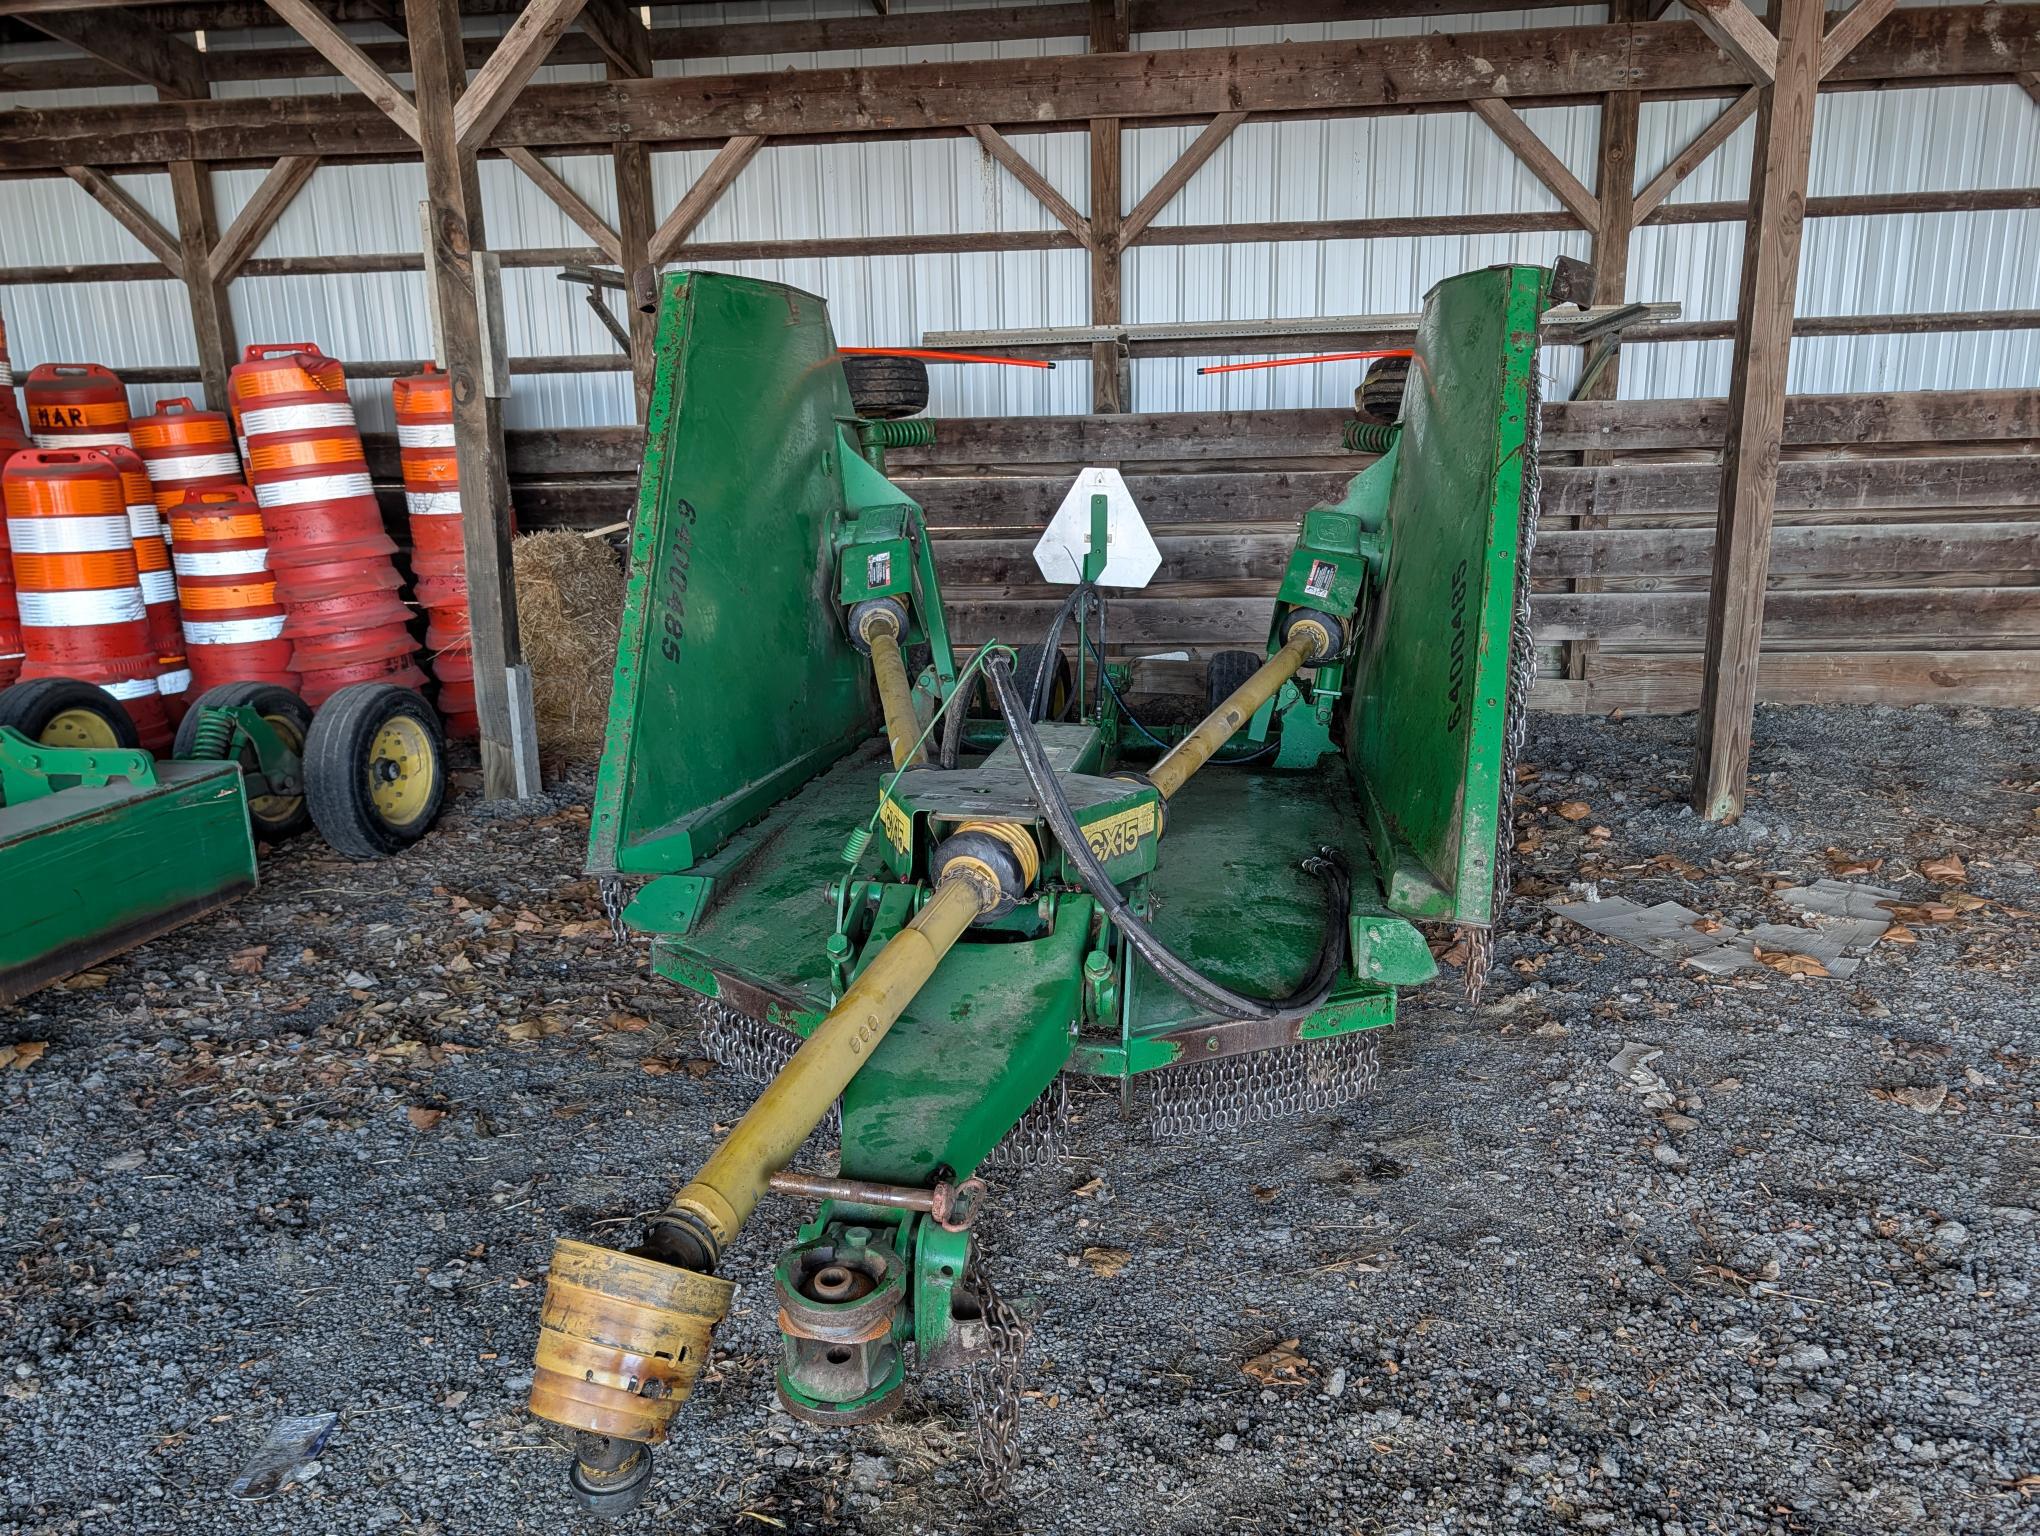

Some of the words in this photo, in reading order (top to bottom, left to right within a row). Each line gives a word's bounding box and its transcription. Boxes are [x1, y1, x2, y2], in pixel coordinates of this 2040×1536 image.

[662, 499, 697, 664] 6400485
[1447, 558, 1468, 733] 6400485
[885, 805, 905, 855] CX15
[1087, 817, 1139, 863] CX15
